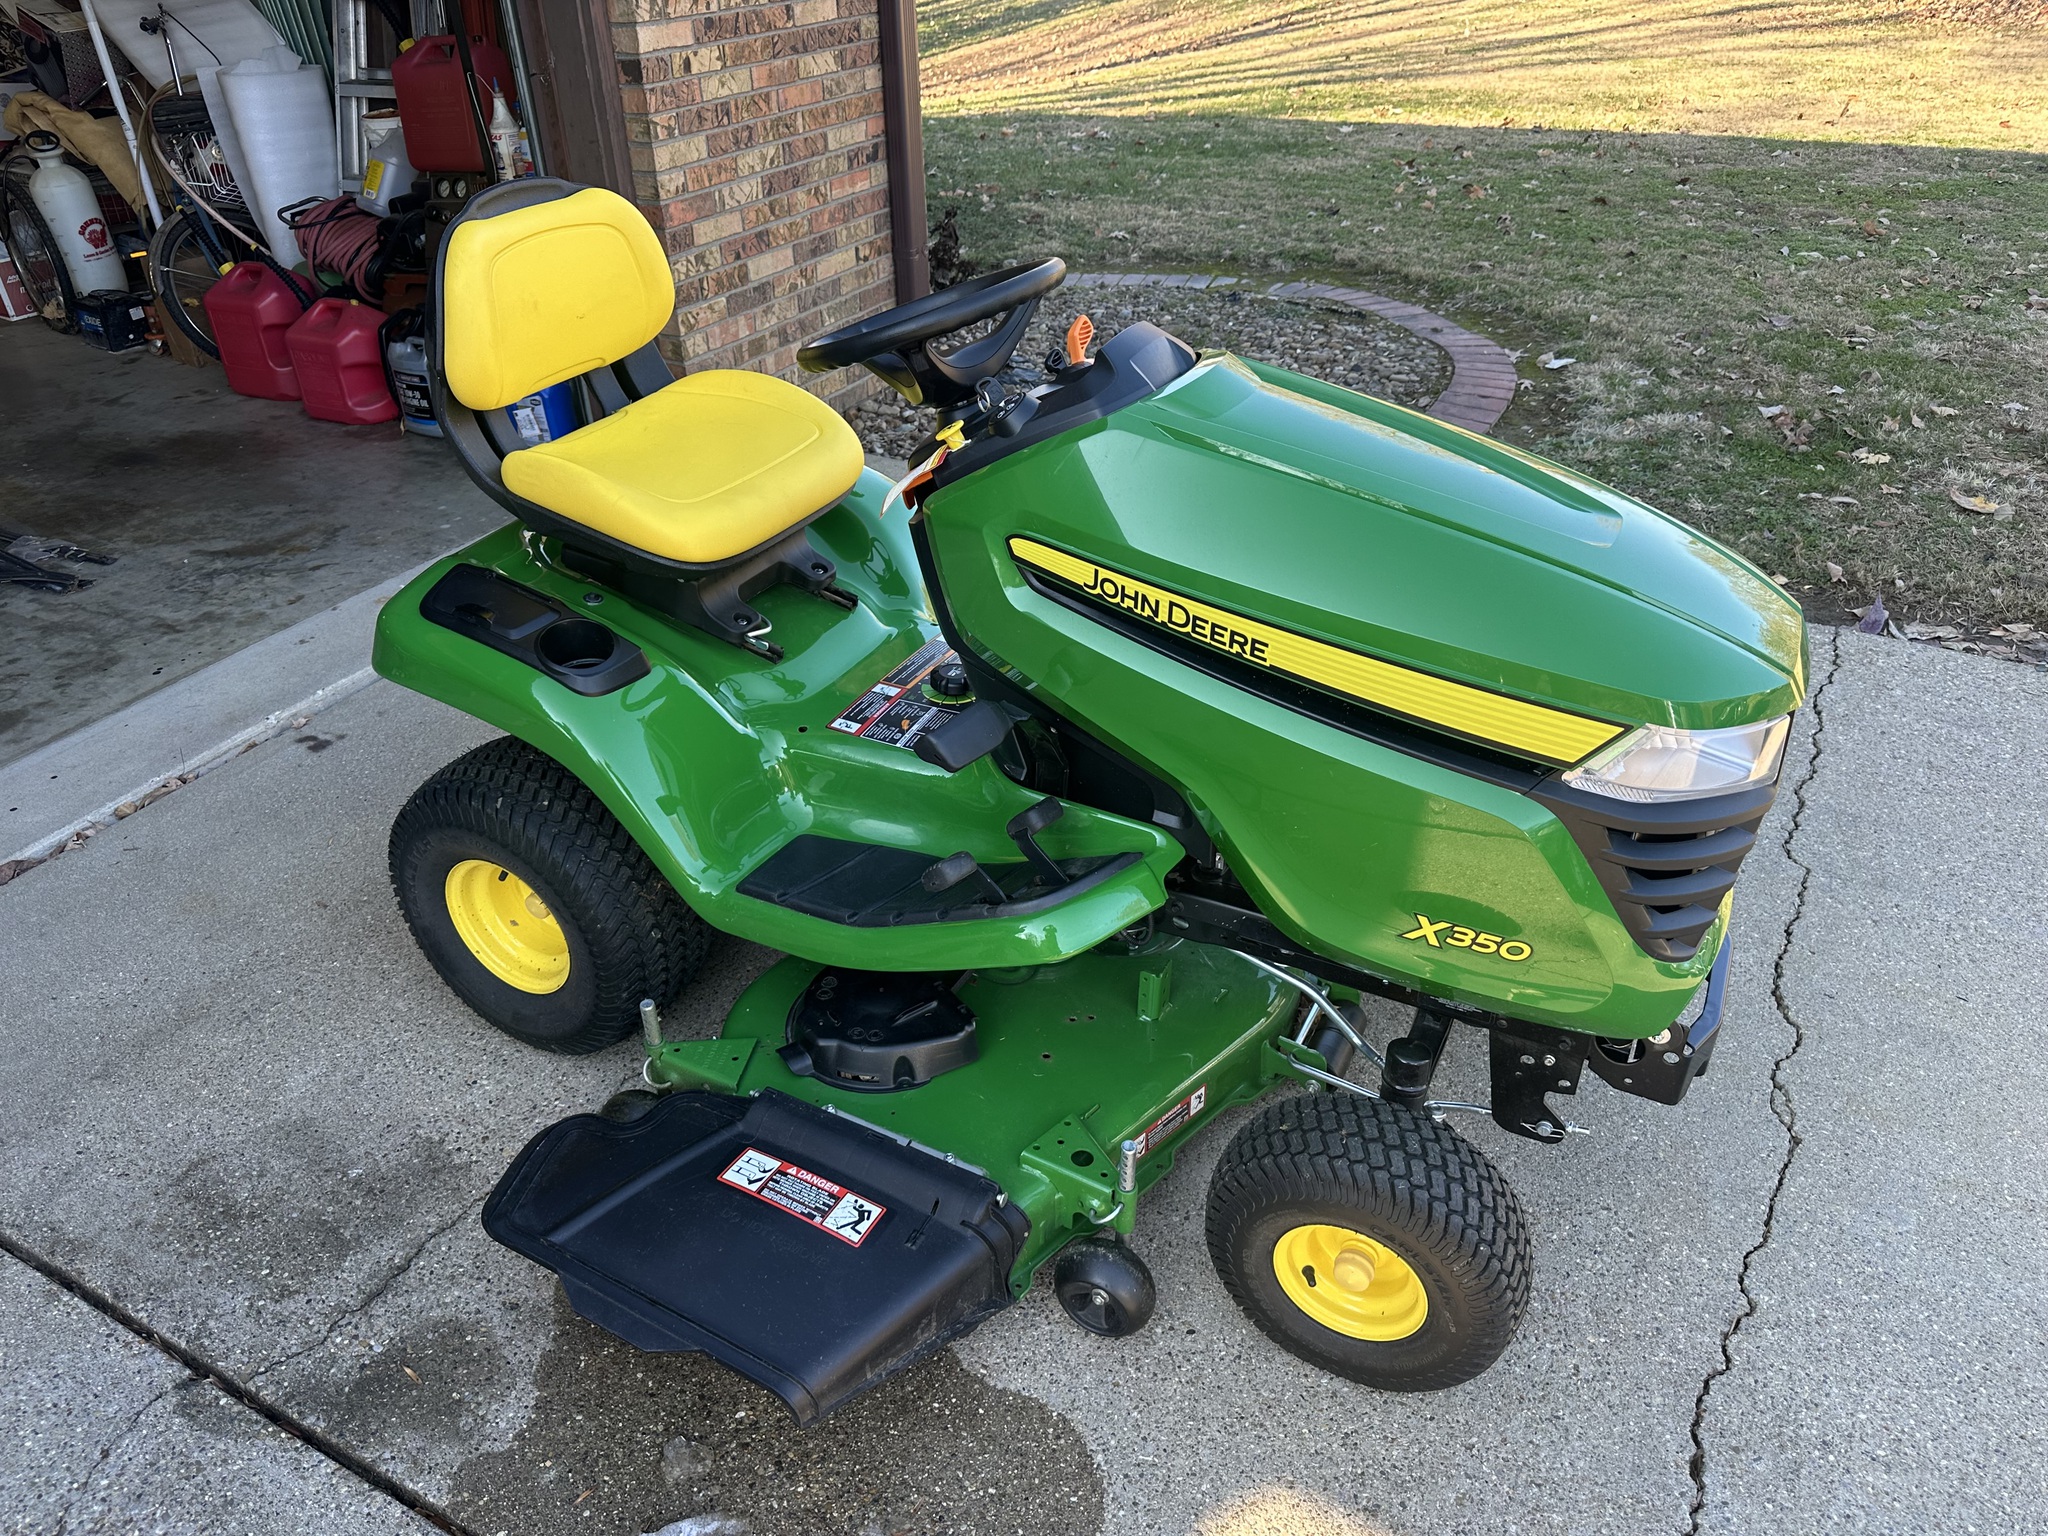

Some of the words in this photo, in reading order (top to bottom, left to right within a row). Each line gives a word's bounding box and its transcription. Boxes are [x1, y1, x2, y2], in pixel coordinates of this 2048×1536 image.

[84, 315, 102, 327] EXIDE
[1083, 568, 1159, 618] JOHN
[1168, 600, 1269, 662] DEERE
[1398, 912, 1533, 961] X350
[798, 1169, 840, 1194] DANGER
